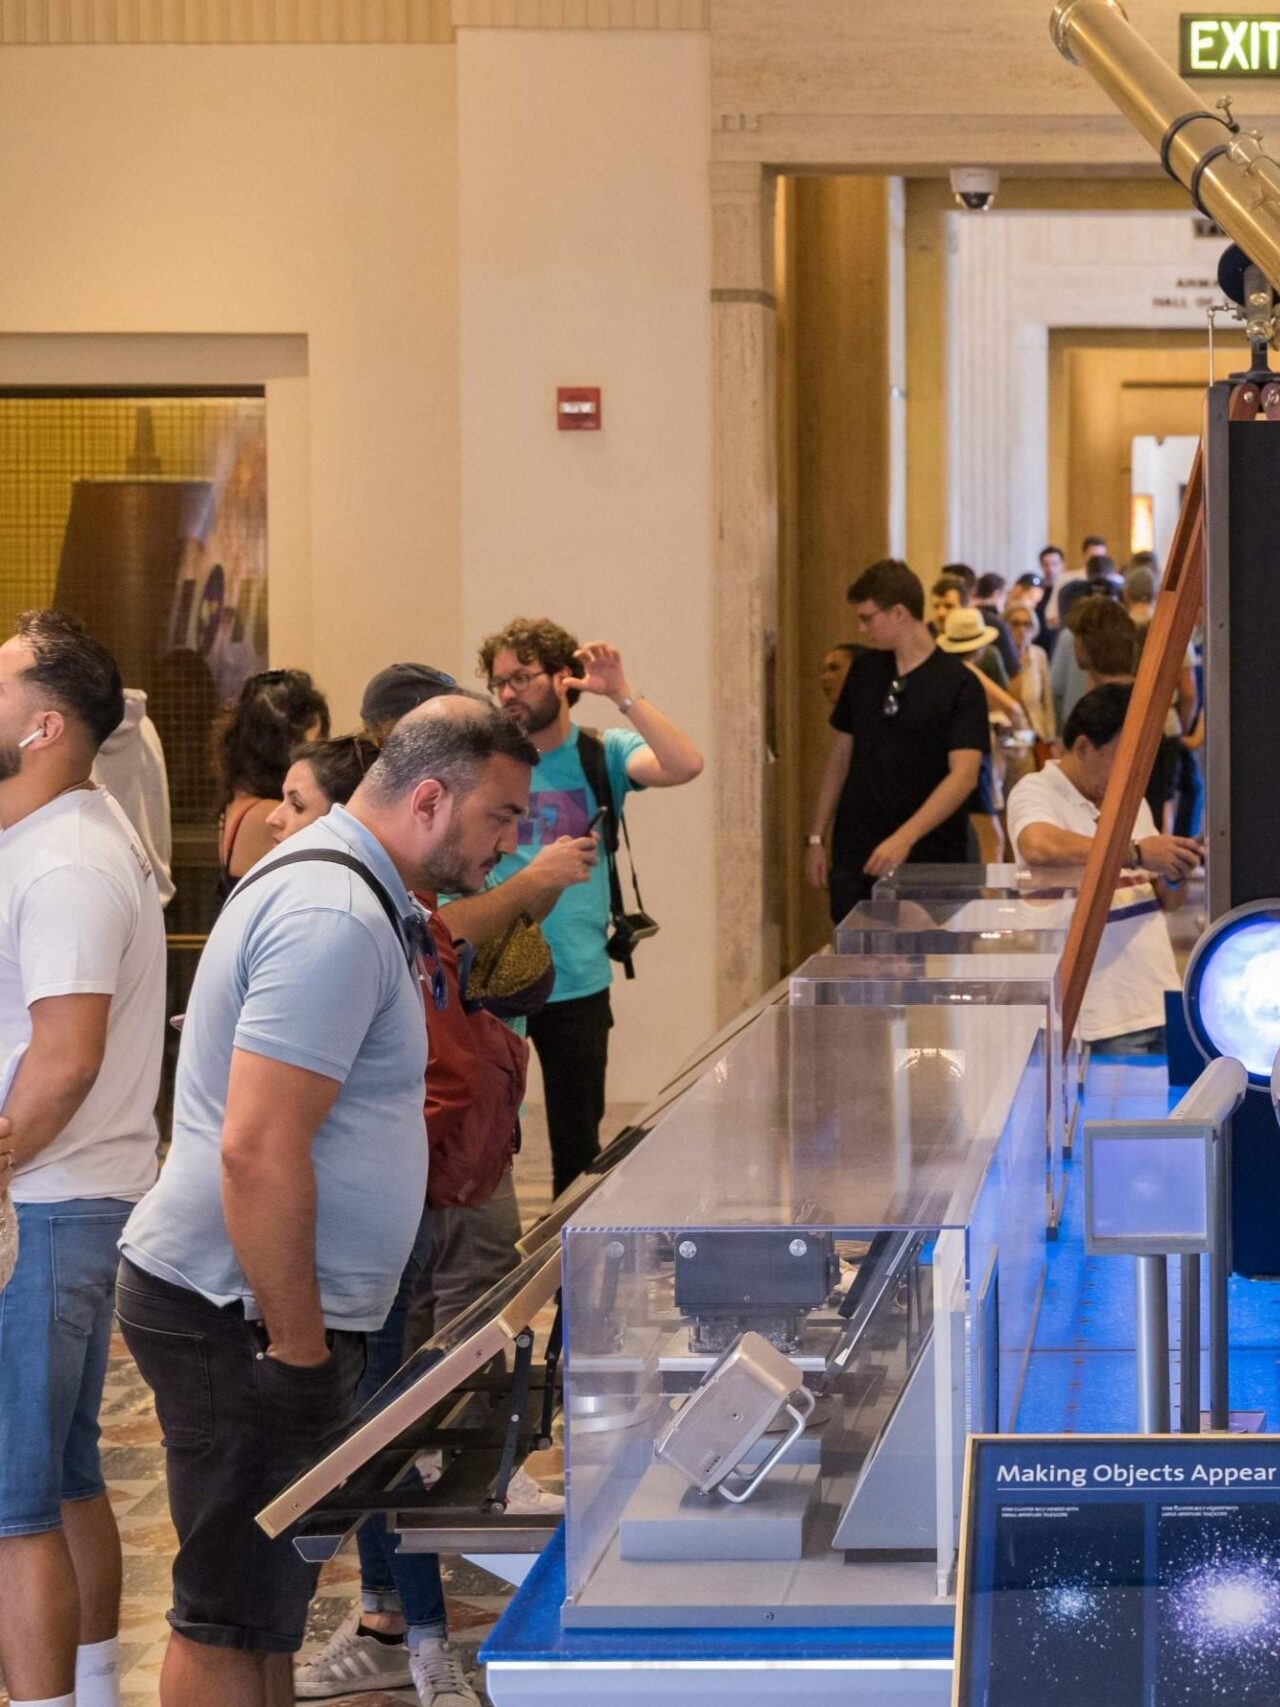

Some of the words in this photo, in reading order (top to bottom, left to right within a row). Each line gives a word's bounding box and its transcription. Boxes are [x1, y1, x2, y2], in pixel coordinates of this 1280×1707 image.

[997, 1464, 1087, 1487] Making
[1093, 1464, 1184, 1485] Objects
[1191, 1463, 1276, 1485] Appear
